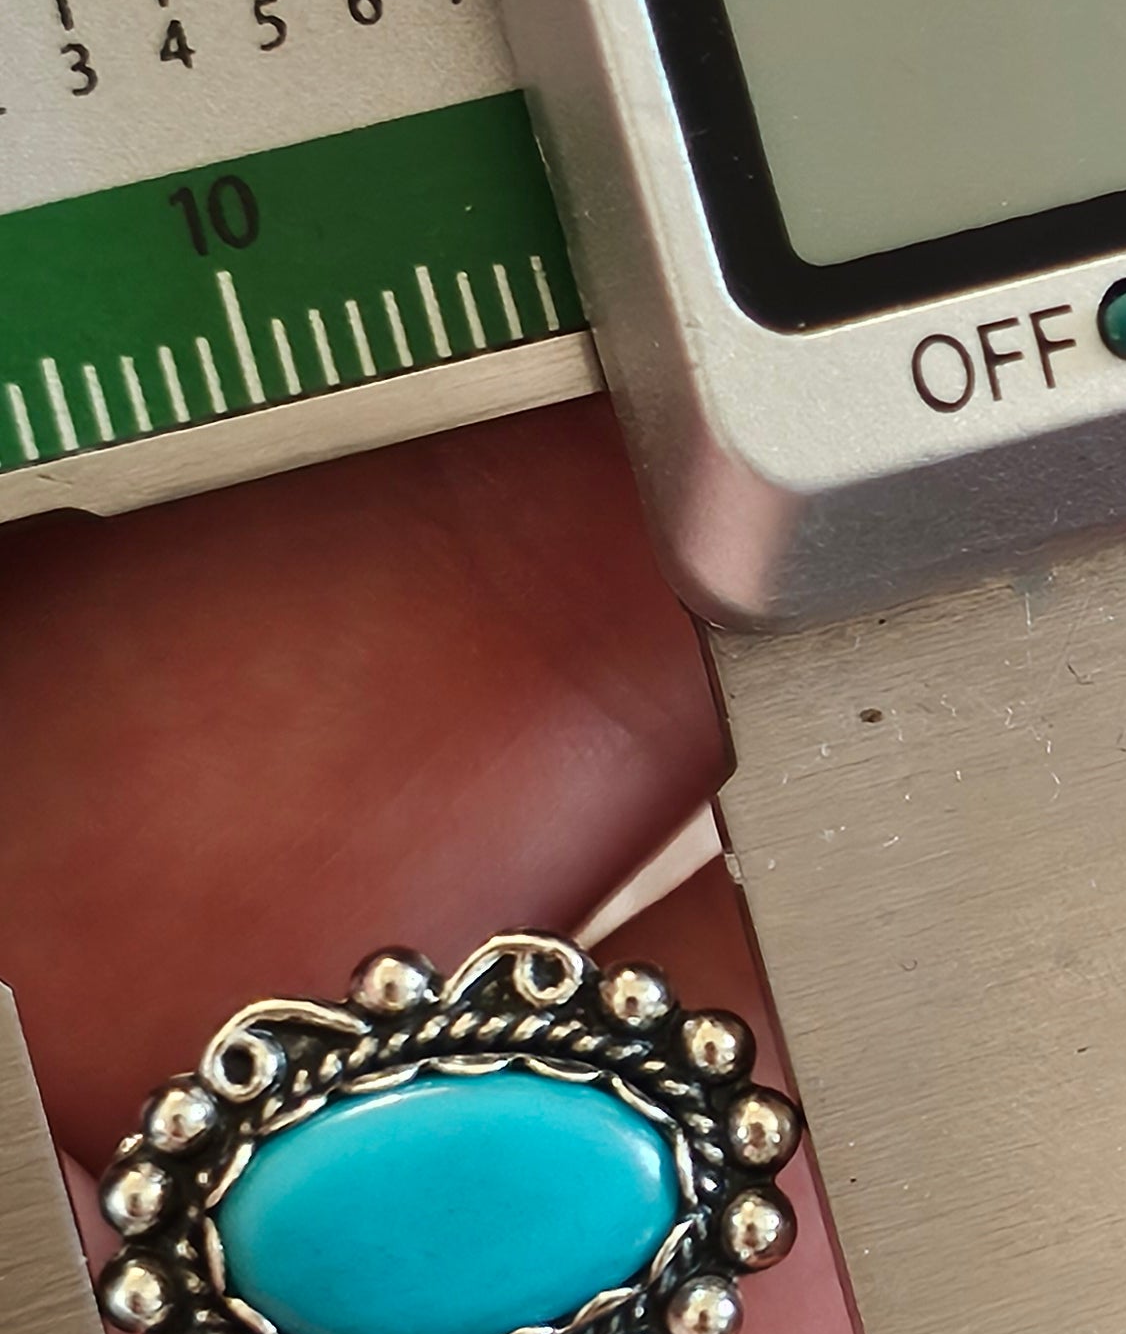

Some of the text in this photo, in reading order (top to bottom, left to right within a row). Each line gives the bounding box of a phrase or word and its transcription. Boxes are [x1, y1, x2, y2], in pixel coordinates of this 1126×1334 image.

[60, 43, 98, 97] 3
[159, 19, 196, 69] 4
[168, 174, 260, 257] 10
[910, 303, 1078, 415] OFF
